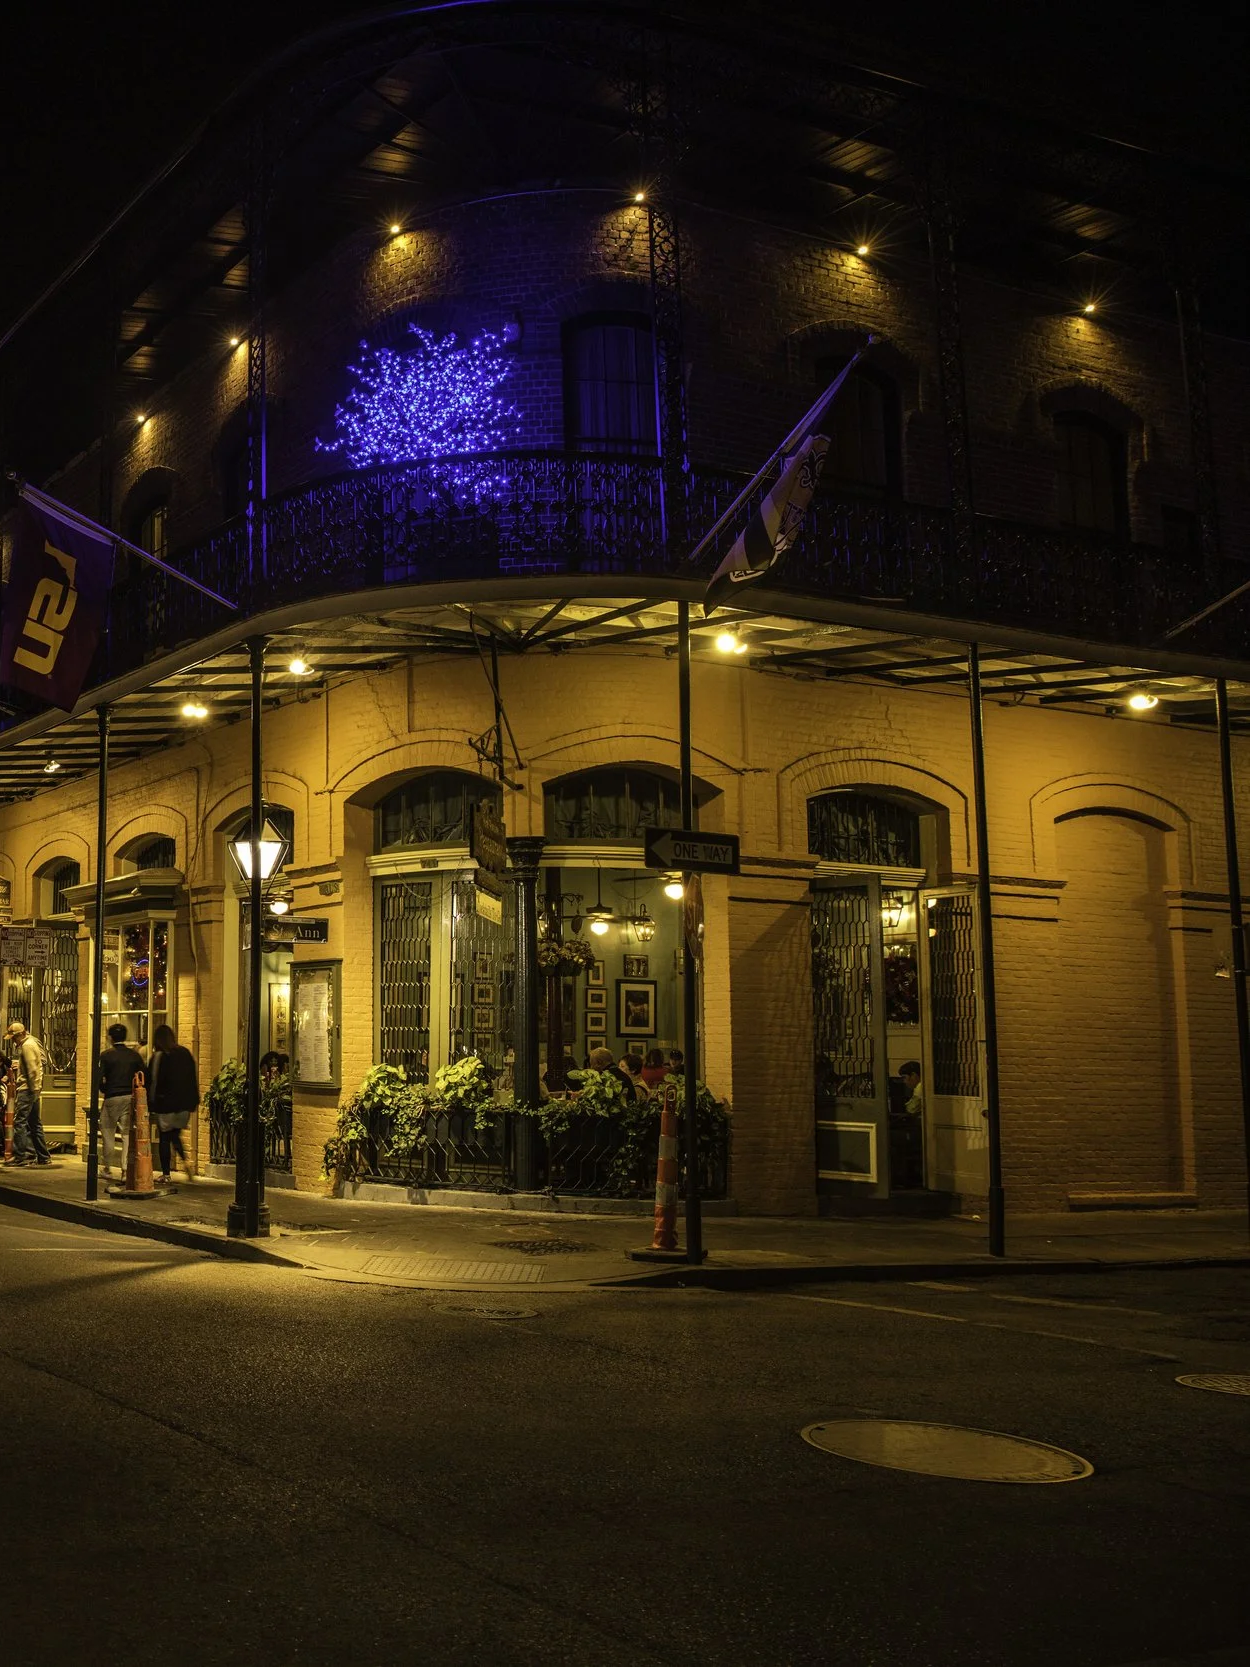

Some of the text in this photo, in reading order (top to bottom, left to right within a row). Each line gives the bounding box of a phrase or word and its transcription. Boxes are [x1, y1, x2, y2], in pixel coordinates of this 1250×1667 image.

[673, 842, 730, 862] ONE WAY
[294, 925, 320, 939] Ann
